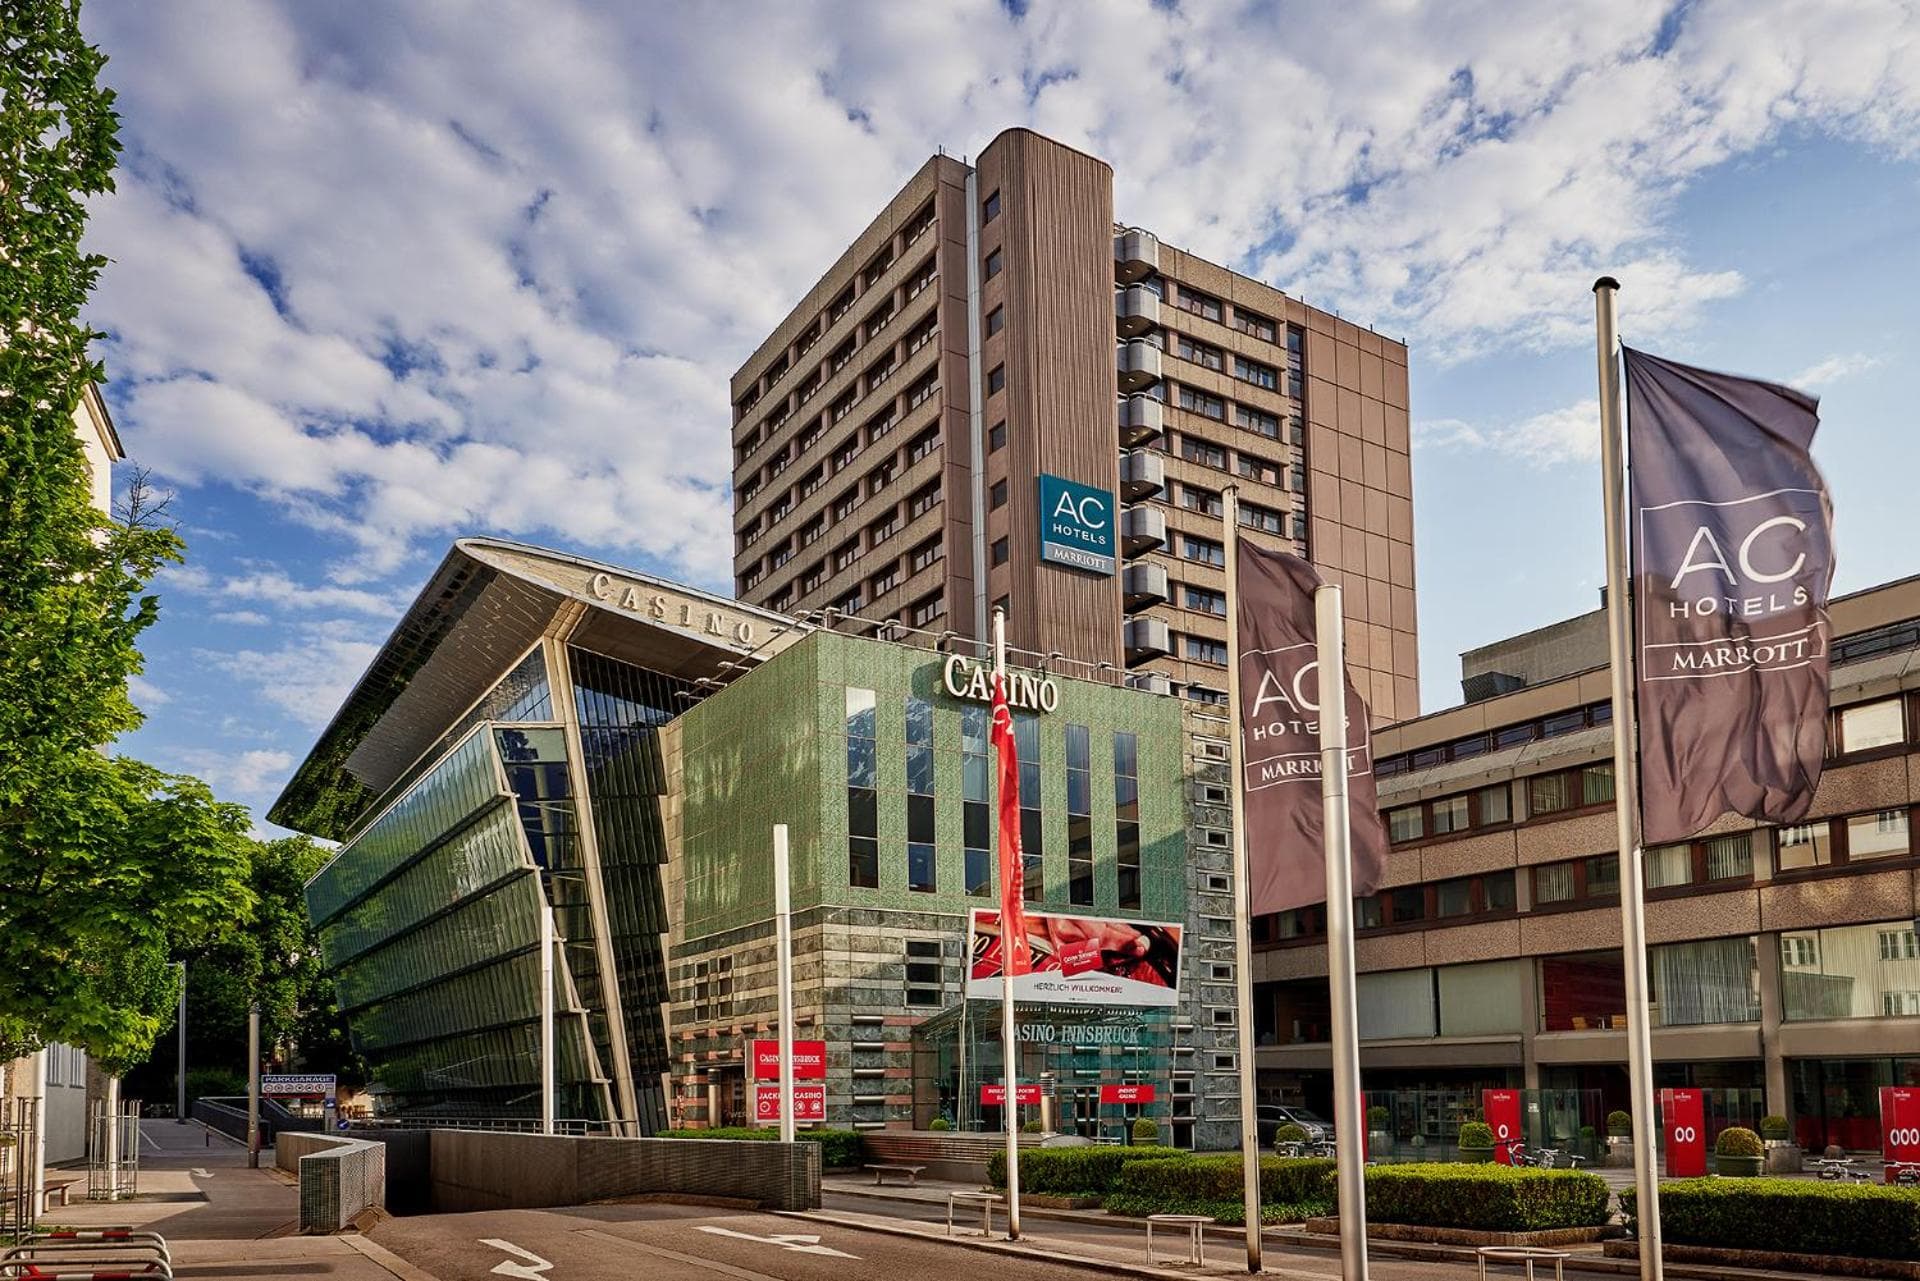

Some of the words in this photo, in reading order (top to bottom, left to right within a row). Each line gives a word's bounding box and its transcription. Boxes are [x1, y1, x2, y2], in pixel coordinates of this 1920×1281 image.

[1053, 490, 1105, 529] AC
[1052, 523, 1106, 545] HOTELS
[1053, 548, 1106, 569] MARRIOTT
[1670, 515, 1807, 590] AC
[589, 572, 753, 643] CASINO
[1670, 585, 1808, 619] HOTELS
[1671, 638, 1808, 671] MARROTT
[1252, 716, 1351, 741] HOTES
[1261, 755, 1356, 781] MARRIT
[1033, 982, 1069, 991] HERZLICH
[1000, 1023, 1055, 1043] ASINO
[1061, 1024, 1139, 1045] INNSBRUCK
[758, 1092, 780, 1100] JACK
